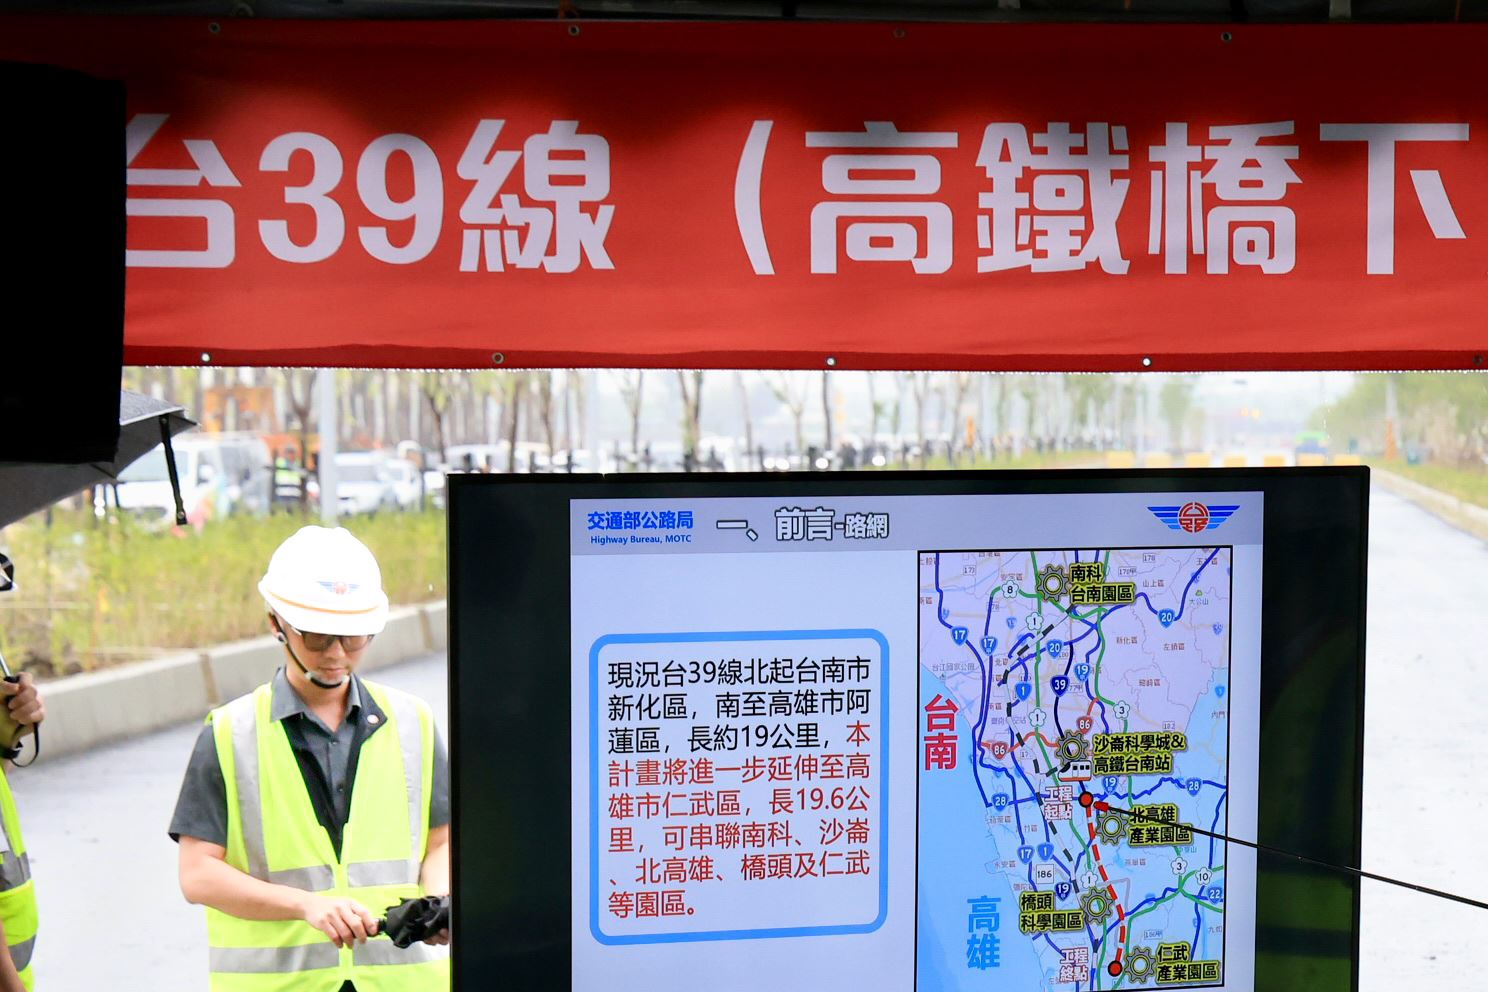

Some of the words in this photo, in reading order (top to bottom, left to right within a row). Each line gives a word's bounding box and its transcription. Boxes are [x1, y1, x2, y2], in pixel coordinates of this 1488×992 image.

[587, 510, 694, 530] 交通部公路局
[591, 535, 628, 545] Highway
[630, 535, 662, 544] Bureau,
[665, 534, 692, 543] MOTC
[1070, 564, 1102, 583] 南科
[1071, 584, 1133, 603] 台南園區
[1161, 612, 1172, 622] 20
[954, 630, 966, 640] 17
[1049, 644, 1060, 653] 20
[607, 655, 871, 689] 現況台39線北起台南市
[1054, 679, 1066, 690] 39
[607, 688, 871, 722] 新化區，南至高雄市阿
[924, 693, 959, 771] 台南
[1079, 720, 1090, 729] 86
[607, 720, 871, 755] 蓮區，長約19公里，本
[1094, 734, 1184, 752] 沙崙科學城&
[994, 745, 1005, 754] 86
[607, 752, 871, 788] 計畫將進一步延伸至高
[1094, 754, 1170, 774] 高鐵台南站
[1045, 785, 1073, 802] 工程
[1188, 781, 1199, 791] 28
[607, 785, 871, 820] 雄市仁武區，長19.6公
[995, 796, 1006, 806] 28
[1045, 803, 1073, 820] 起點
[1130, 806, 1176, 824] 北高雄
[607, 817, 871, 853] 里，可串聯南科、沙崙
[1130, 827, 1191, 844] 產業園區
[1020, 849, 1032, 859] 17
[609, 850, 870, 886] 、北高雄、橋頭及仁武
[1037, 869, 1052, 878] 186
[608, 890, 695, 918] 等園區。
[1021, 893, 1052, 911] 橋頭
[1021, 912, 1082, 931] 科學園區
[967, 895, 1002, 971] 高雄
[1060, 947, 1088, 964] 工程
[1158, 945, 1188, 963] 仁武
[1059, 965, 1088, 983] 終點
[1158, 963, 1217, 982] 產業園區
